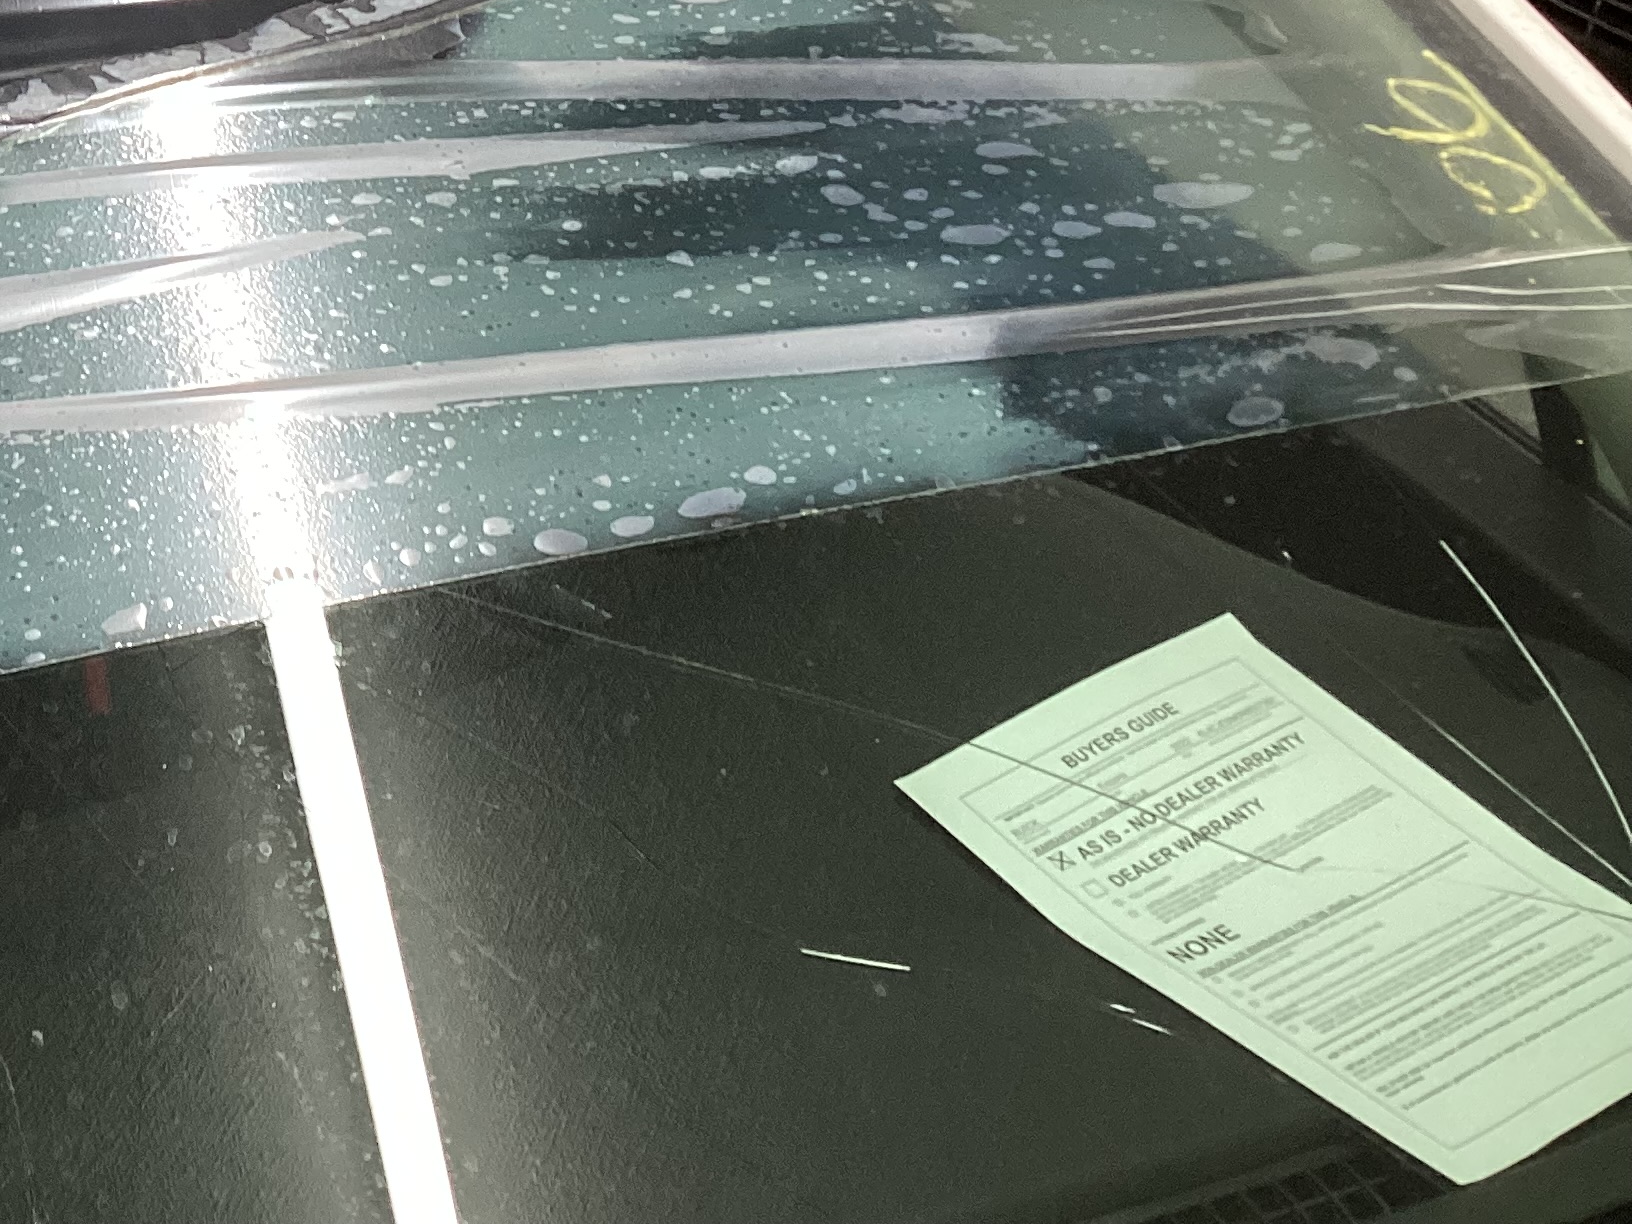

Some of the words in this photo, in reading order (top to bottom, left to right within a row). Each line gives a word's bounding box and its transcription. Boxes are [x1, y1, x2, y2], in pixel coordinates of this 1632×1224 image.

[1060, 726, 1130, 769] BUYERS
[1127, 701, 1180, 733] GUIDE
[1077, 839, 1104, 861] AS
[1099, 829, 1122, 847] IS
[1126, 810, 1158, 832] NO
[1154, 774, 1224, 818] DEALER
[1216, 731, 1305, 783] WARRANTY
[1108, 846, 1180, 888] DEALER
[1171, 796, 1266, 854] WARRANTY
[1166, 923, 1242, 964] NONE
